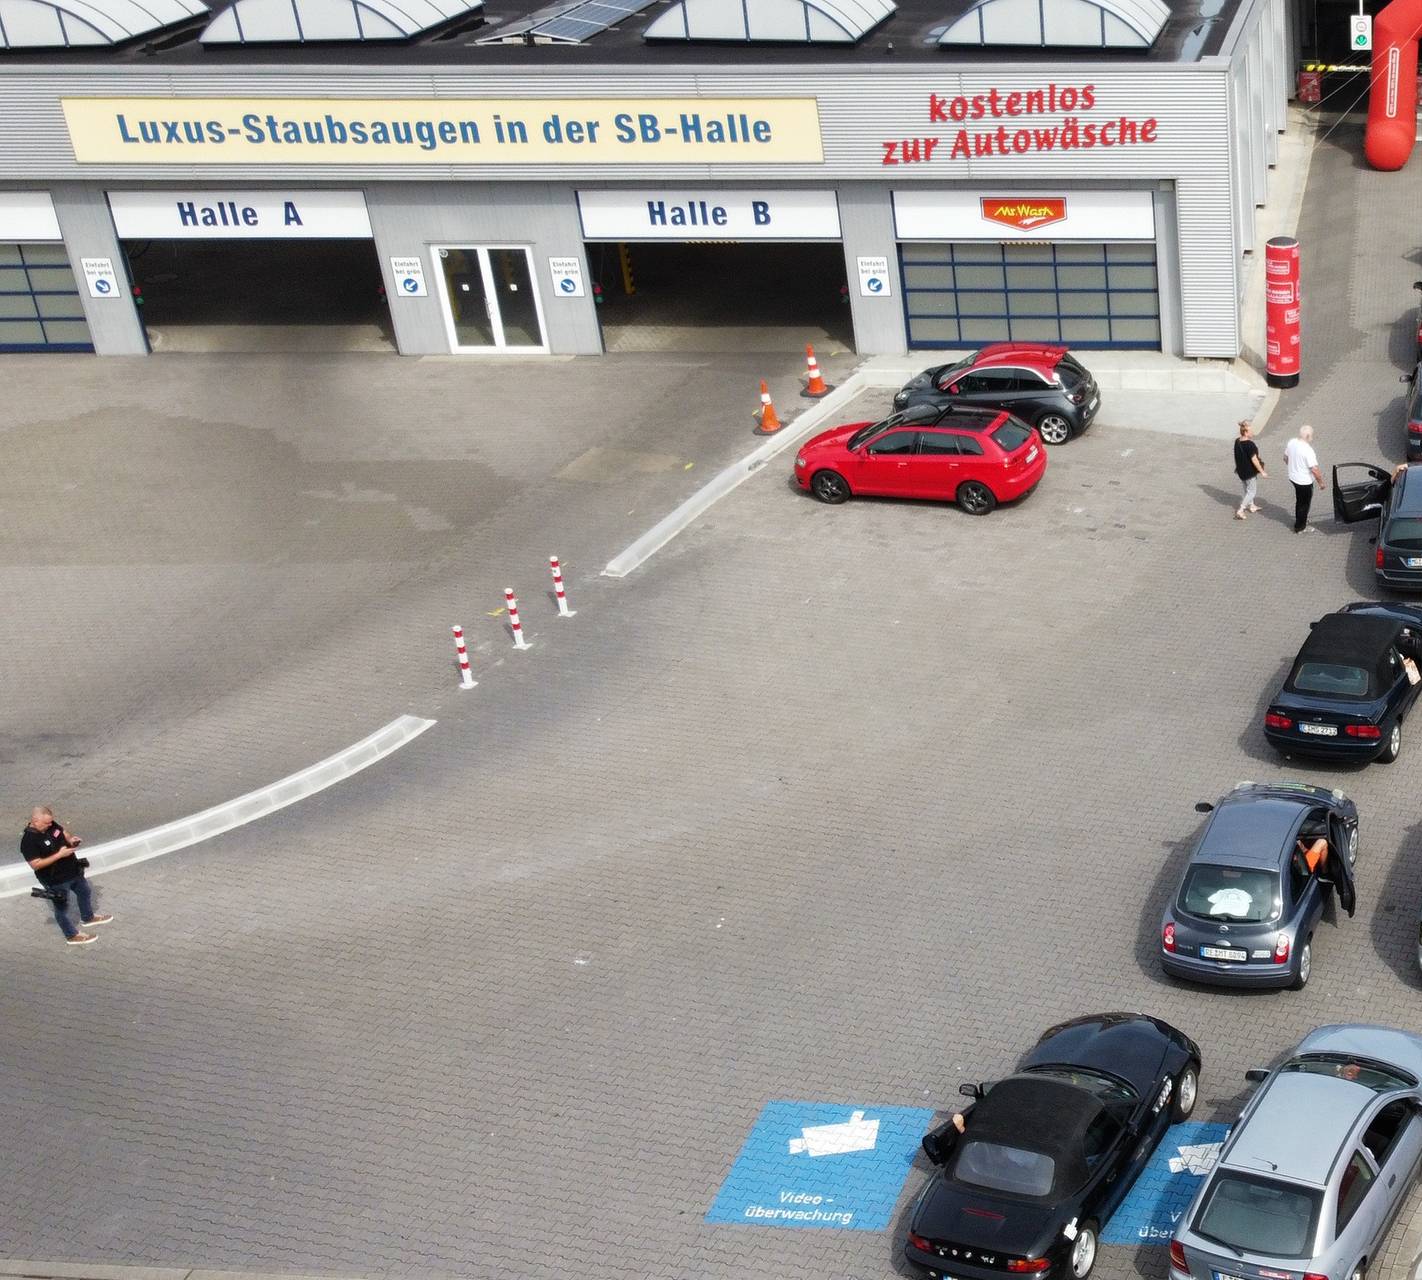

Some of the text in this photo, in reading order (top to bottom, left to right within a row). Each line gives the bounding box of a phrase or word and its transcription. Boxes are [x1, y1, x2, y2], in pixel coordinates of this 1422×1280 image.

[929, 84, 1096, 123] kostenlos
[116, 114, 772, 150] Luxus-Staubsaugen in der SB-Halle
[882, 117, 1157, 165] zur Autowäsche
[177, 201, 303, 226] Halle A
[647, 201, 771, 226] Halle B
[780, 1191, 823, 1205] Video
[745, 1205, 853, 1225] überwachung
